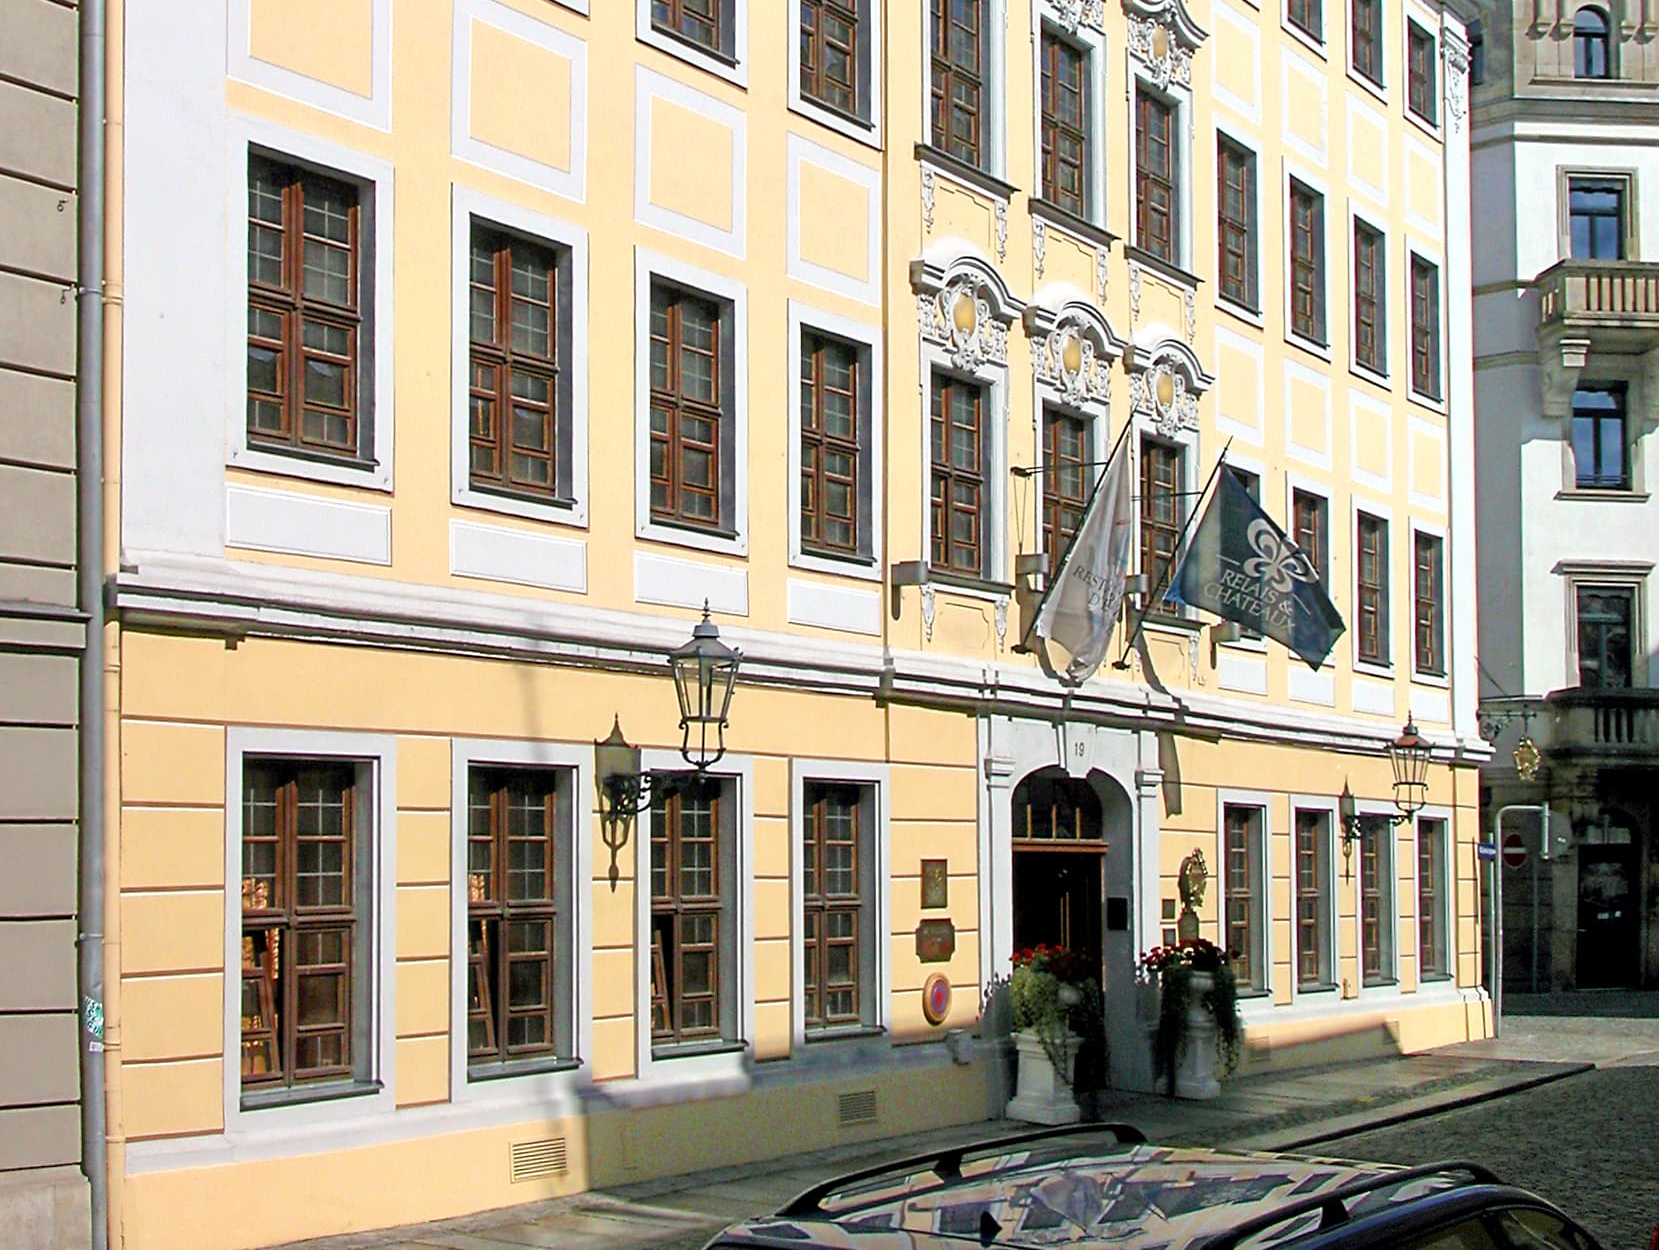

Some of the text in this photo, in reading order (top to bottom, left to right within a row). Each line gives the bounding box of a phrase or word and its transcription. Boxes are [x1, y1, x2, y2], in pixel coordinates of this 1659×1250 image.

[1204, 582, 1296, 634] CHATEAUX
[1221, 569, 1294, 617] RELAIS &
[1074, 741, 1085, 757] 19
